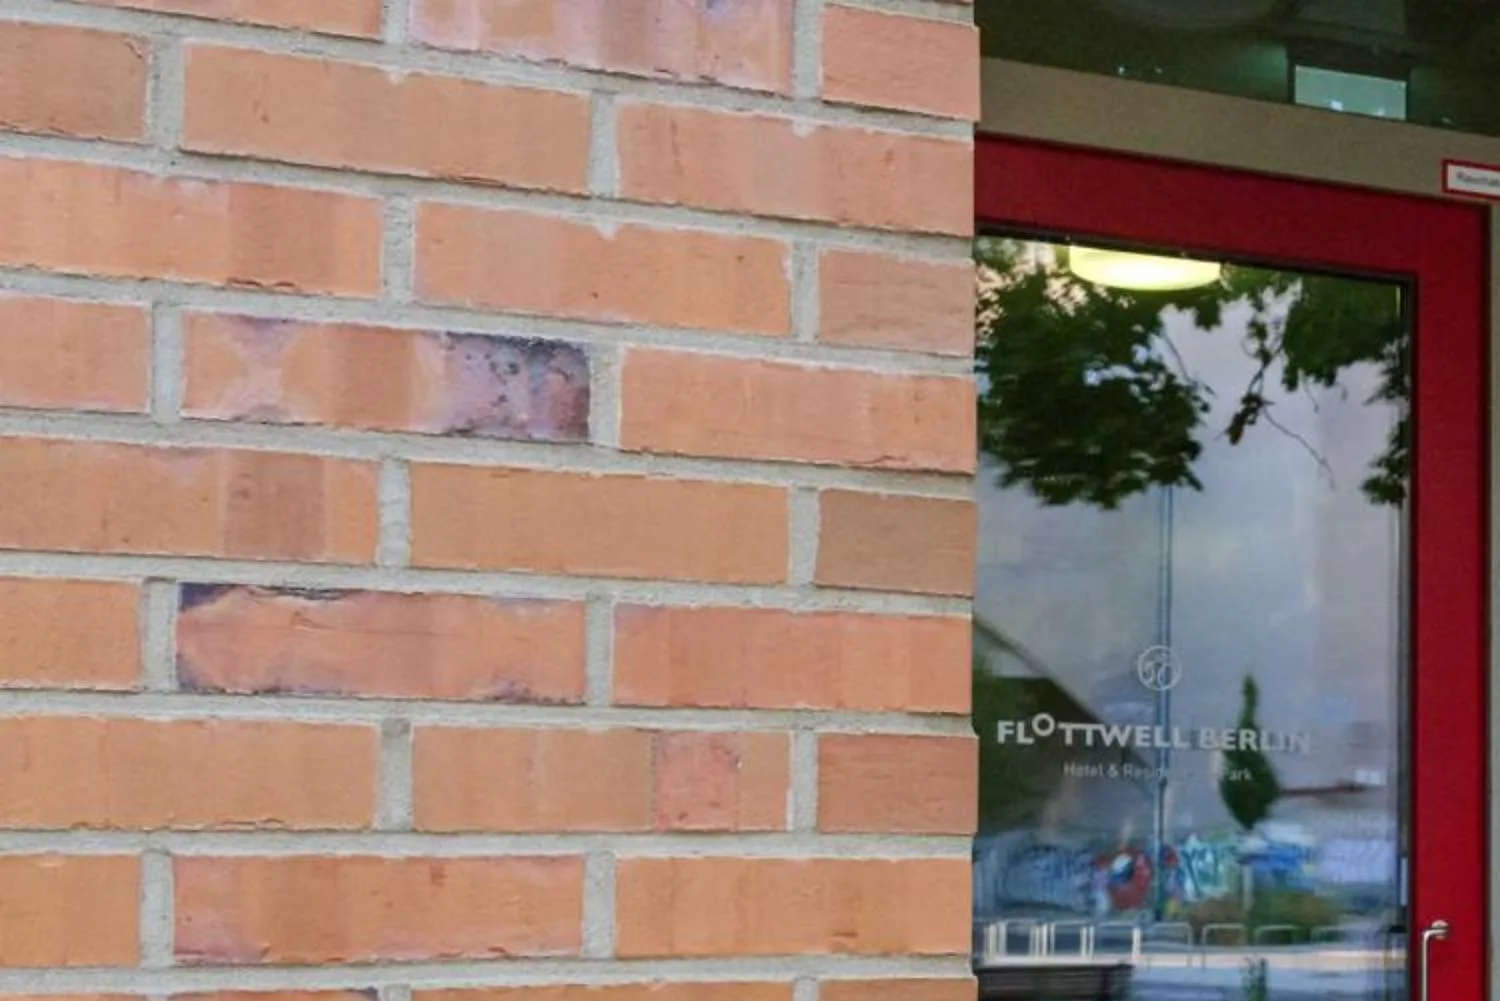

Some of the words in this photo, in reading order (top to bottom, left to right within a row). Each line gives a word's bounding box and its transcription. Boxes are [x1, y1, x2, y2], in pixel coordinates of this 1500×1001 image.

[997, 713, 1191, 748] FLOTTWELL
[1200, 727, 1311, 753] BERLIN
[1063, 761, 1104, 778] Hotel
[1107, 763, 1119, 778] &
